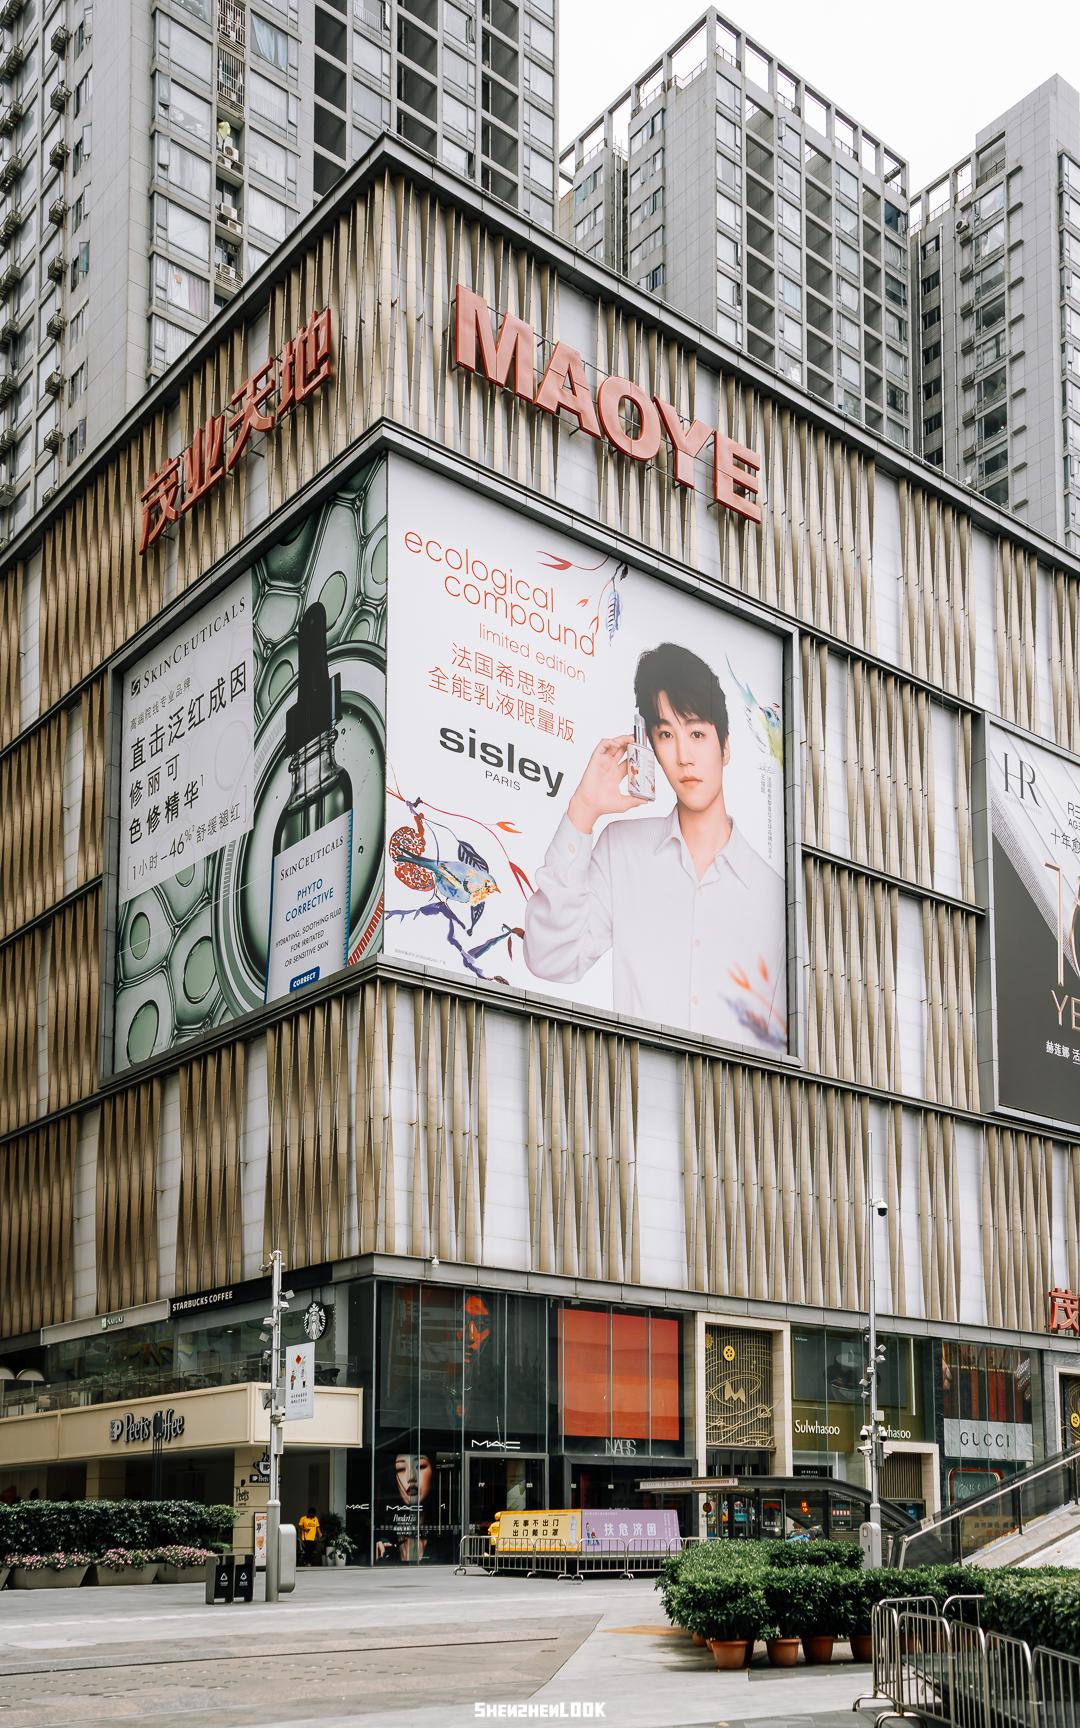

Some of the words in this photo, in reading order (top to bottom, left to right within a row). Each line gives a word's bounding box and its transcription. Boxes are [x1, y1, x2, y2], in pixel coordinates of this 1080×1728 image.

[456, 284, 762, 524] MAOYE
[139, 308, 331, 555] 茂业天地
[404, 531, 554, 613] ecological
[444, 576, 595, 657] compound
[480, 623, 529, 658] limited
[535, 651, 586, 683] edition
[451, 642, 555, 705] 法国希思黎
[130, 661, 246, 772] 直击泛红成因
[428, 666, 574, 744] 全能乳液限量版
[439, 727, 564, 798] sisley
[129, 754, 180, 809] 修丽可
[485, 770, 521, 791] PARIS
[1004, 753, 1041, 808] HR
[285, 887, 334, 922] CORRECTIVE
[297, 878, 323, 900] PHYTO
[284, 958, 293, 968] OR
[317, 940, 329, 952] SKIN
[290, 939, 301, 952] FOR
[293, 971, 316, 988] CORRECT
[172, 1296, 208, 1311] STARBUCKS
[209, 1291, 233, 1303] COFFEE
[124, 1413, 149, 1442] Peet's
[794, 1419, 840, 1435] Sulwhasoo
[960, 1432, 1010, 1447] GUCCI
[605, 1438, 637, 1456] NARS
[512, 1519, 560, 1527] 无事不出门
[604, 1522, 657, 1536] 扶危济困
